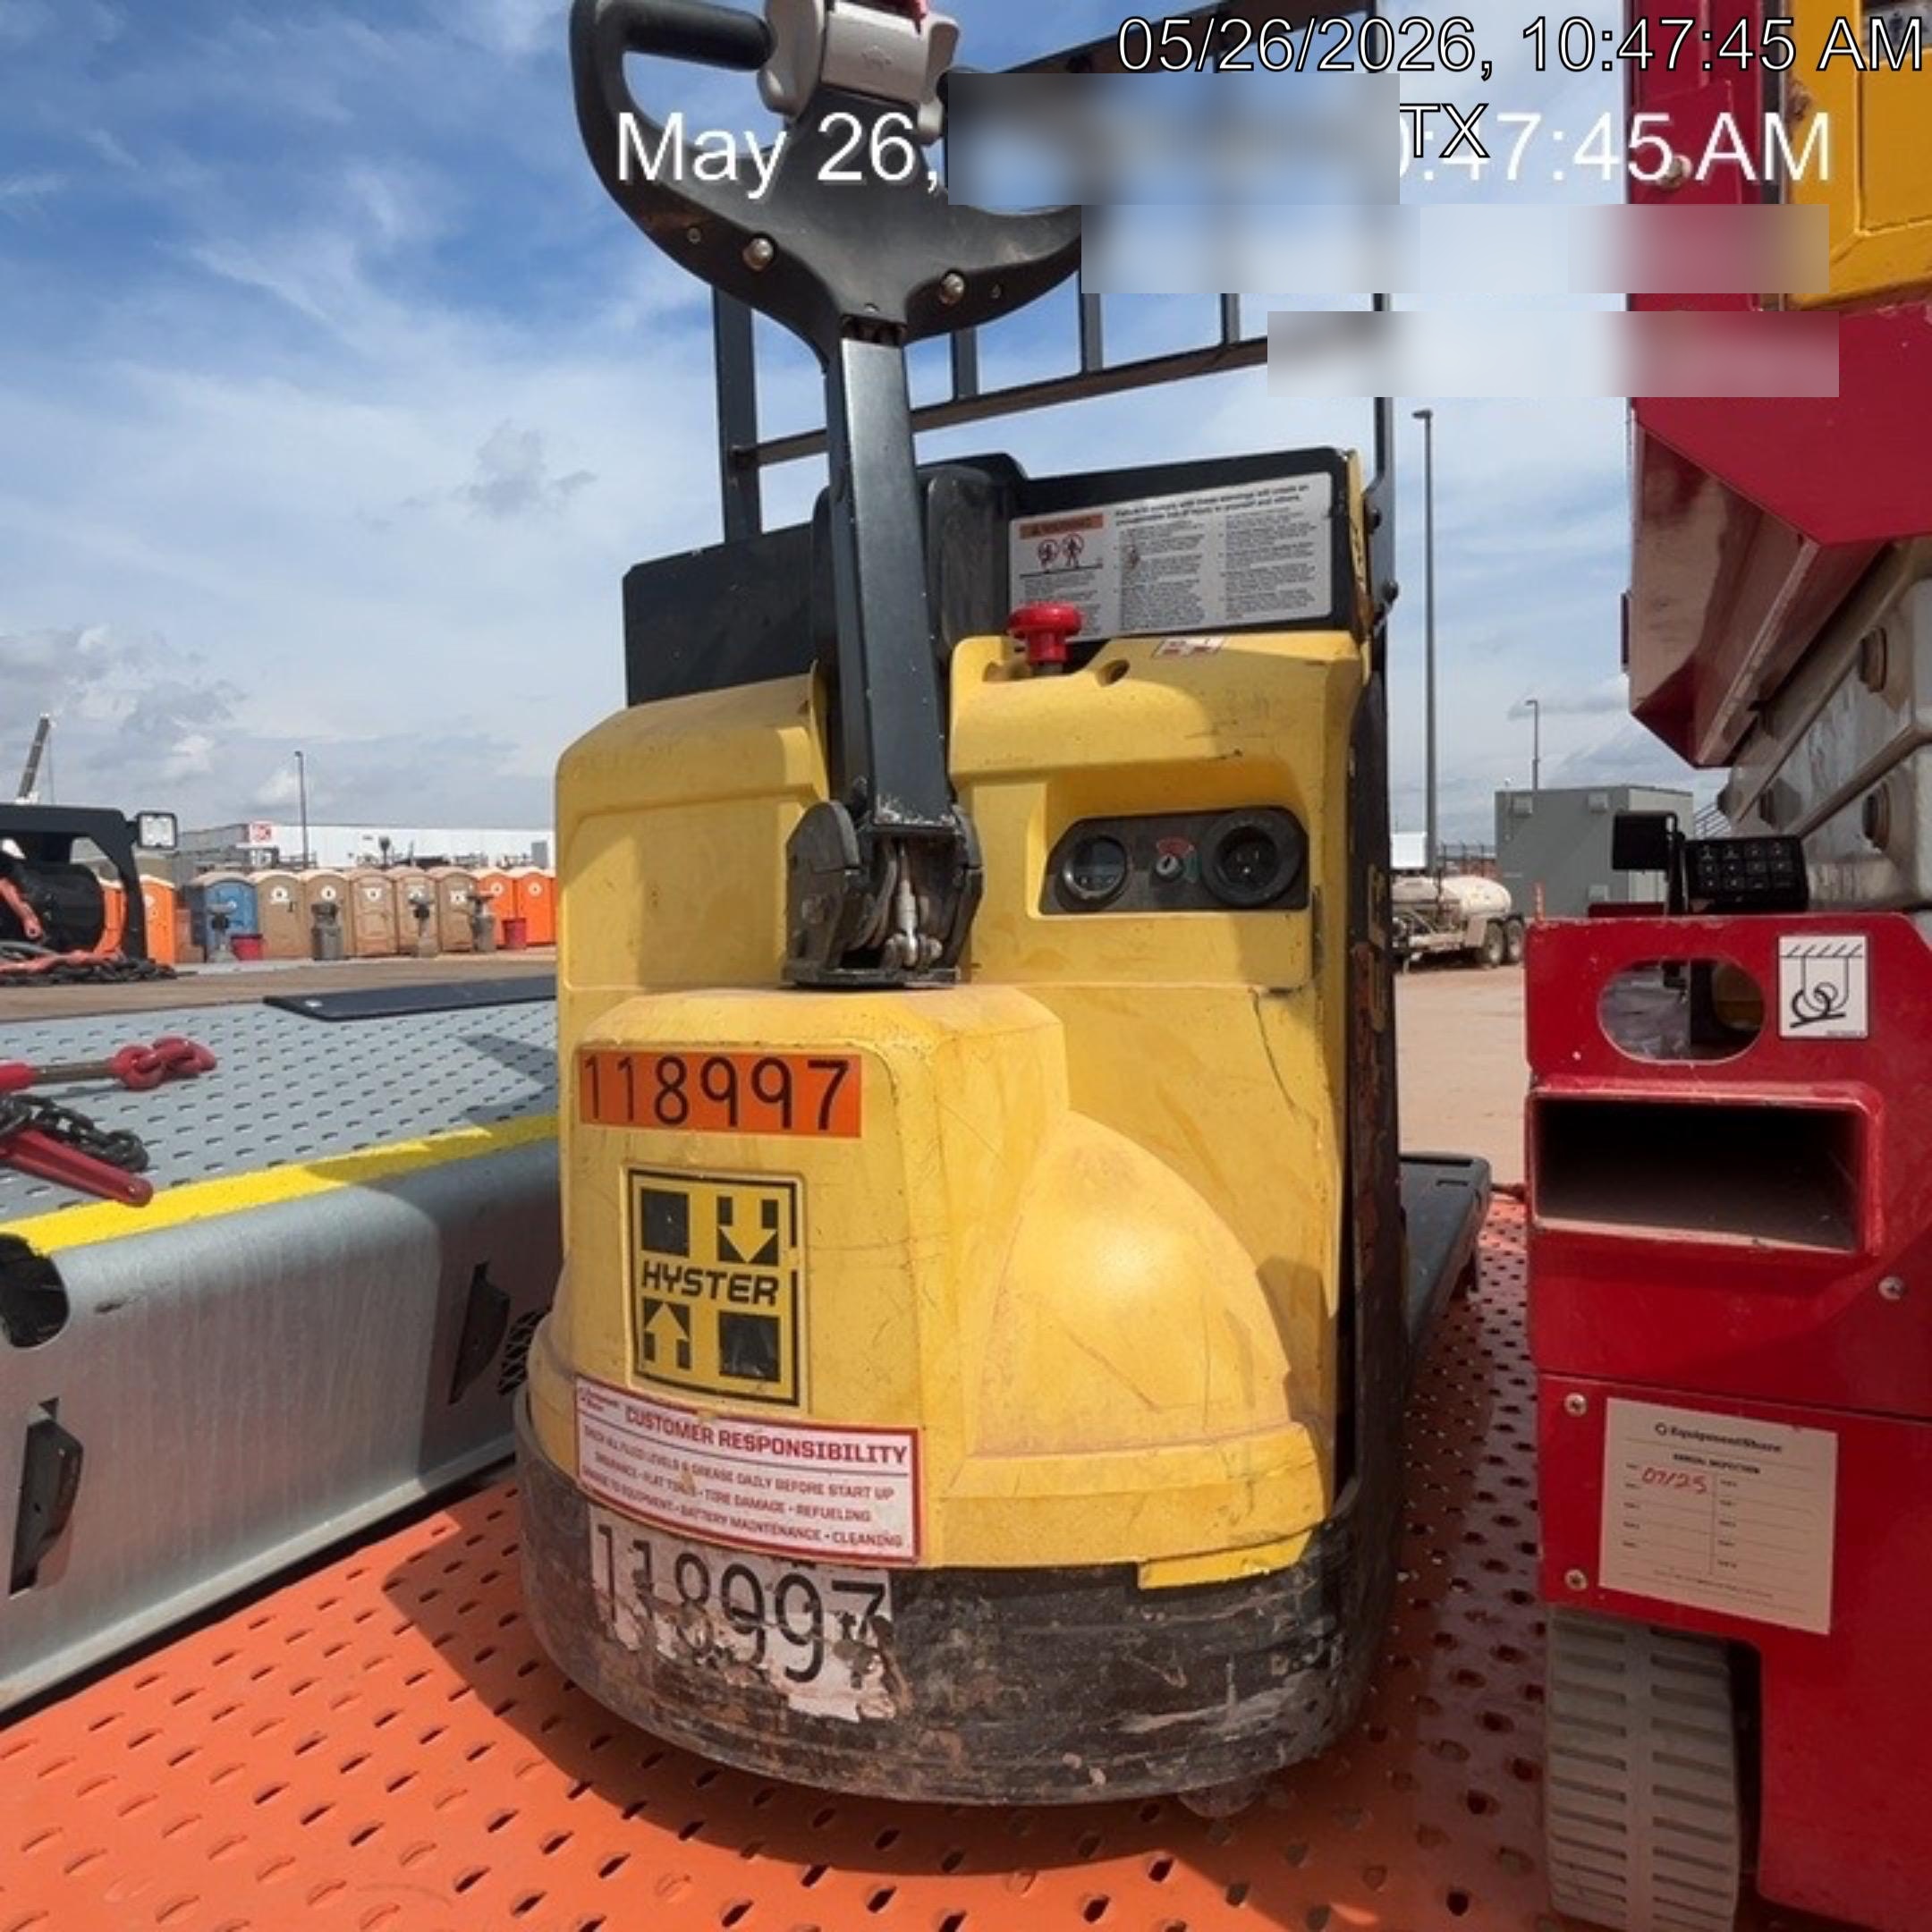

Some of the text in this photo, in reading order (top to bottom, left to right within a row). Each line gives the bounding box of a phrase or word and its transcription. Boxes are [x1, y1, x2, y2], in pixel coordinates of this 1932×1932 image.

[584, 1055, 851, 1131] 118997
[640, 1260, 780, 1307] HYSTER
[625, 1403, 906, 1465] CUSTOMER RESPONSIBILITY
[691, 1462, 733, 1482] GREASE
[737, 1471, 770, 1488] DAILY
[775, 1478, 823, 1495] BEFORE
[828, 1483, 870, 1498] START
[874, 1487, 893, 1500] UP
[734, 1494, 784, 1513] DAMAGE
[795, 1504, 869, 1521] REFUELING
[730, 1515, 820, 1541] MAINTENANCE
[833, 1530, 902, 1547] CLEANING
